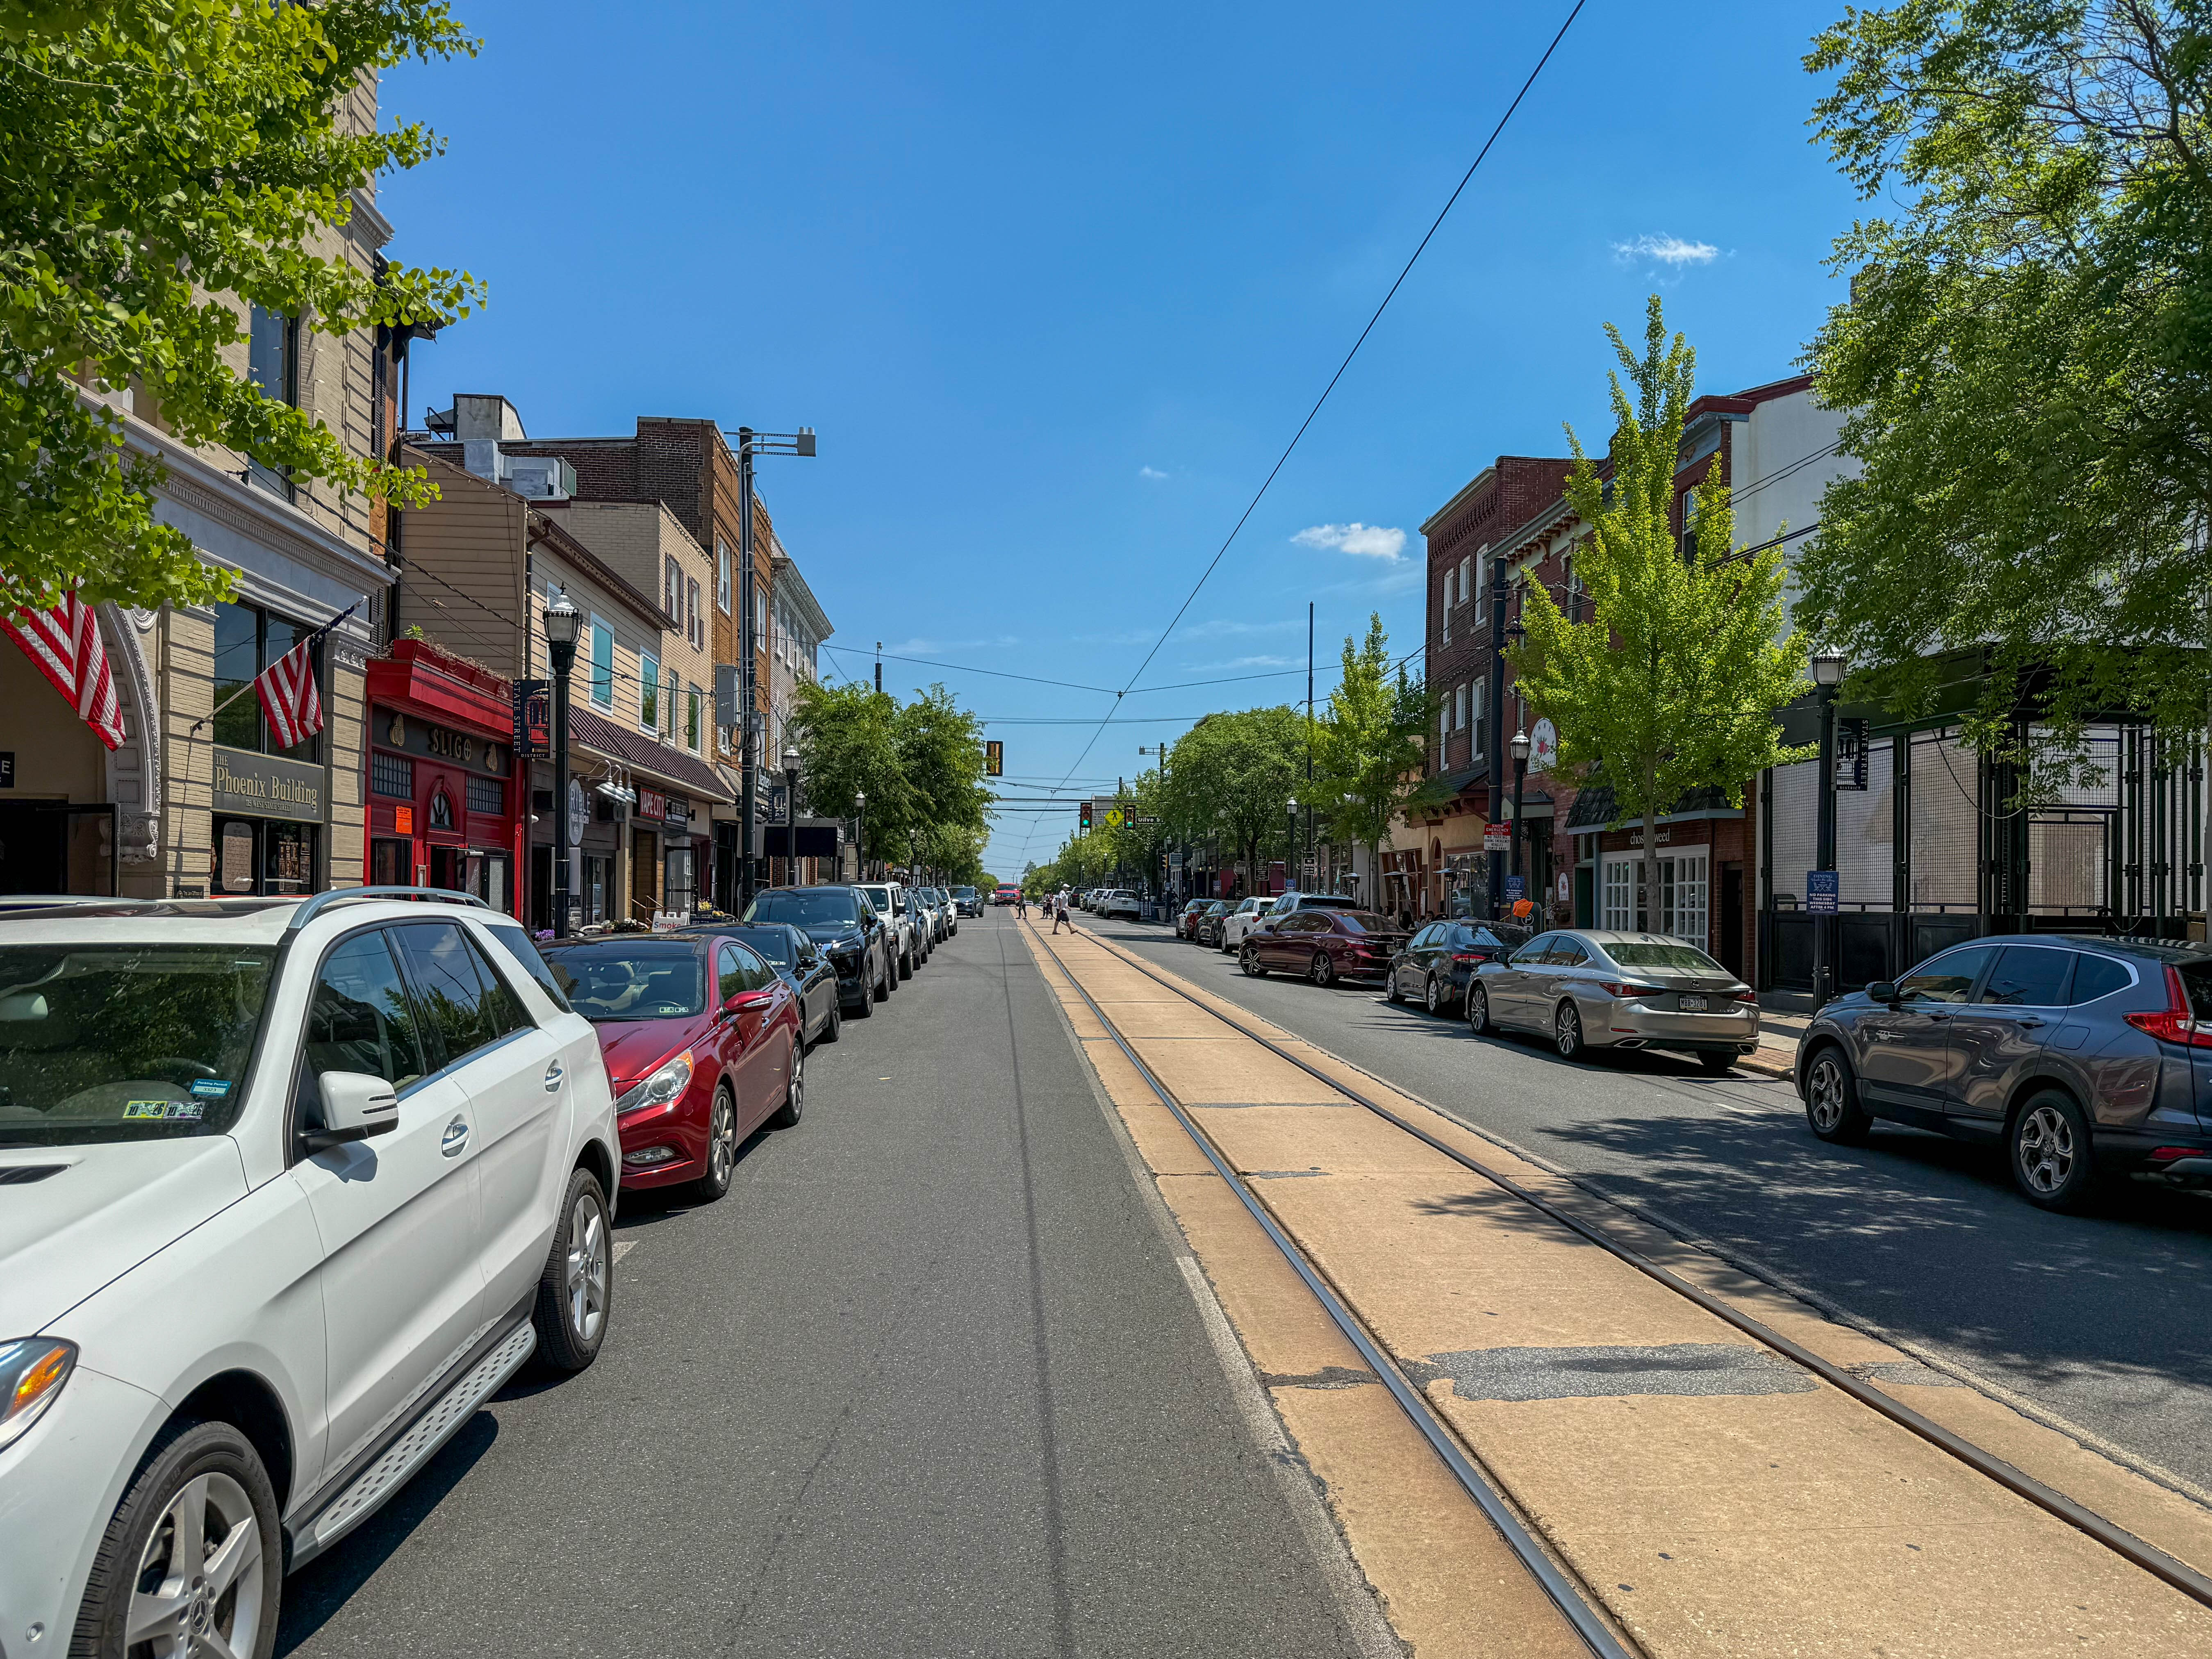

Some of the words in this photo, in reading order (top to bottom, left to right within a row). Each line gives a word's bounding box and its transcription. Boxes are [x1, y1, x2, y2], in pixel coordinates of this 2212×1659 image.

[430, 729, 471, 761] SLIGO
[216, 754, 228, 766] THE
[215, 767, 266, 797] Phoenix
[271, 776, 317, 810] Building
[265, 801, 277, 810] STATE
[277, 803, 291, 812] STREET
[571, 788, 591, 814] RIBLE
[641, 790, 653, 815] VAPE
[654, 795, 665, 817] CITY
[1630, 831, 1644, 844] chos
[128, 1106, 139, 1115] 10
[153, 1104, 164, 1115] 26
[167, 1106, 178, 1116] 10
[191, 1104, 203, 1116] 26
